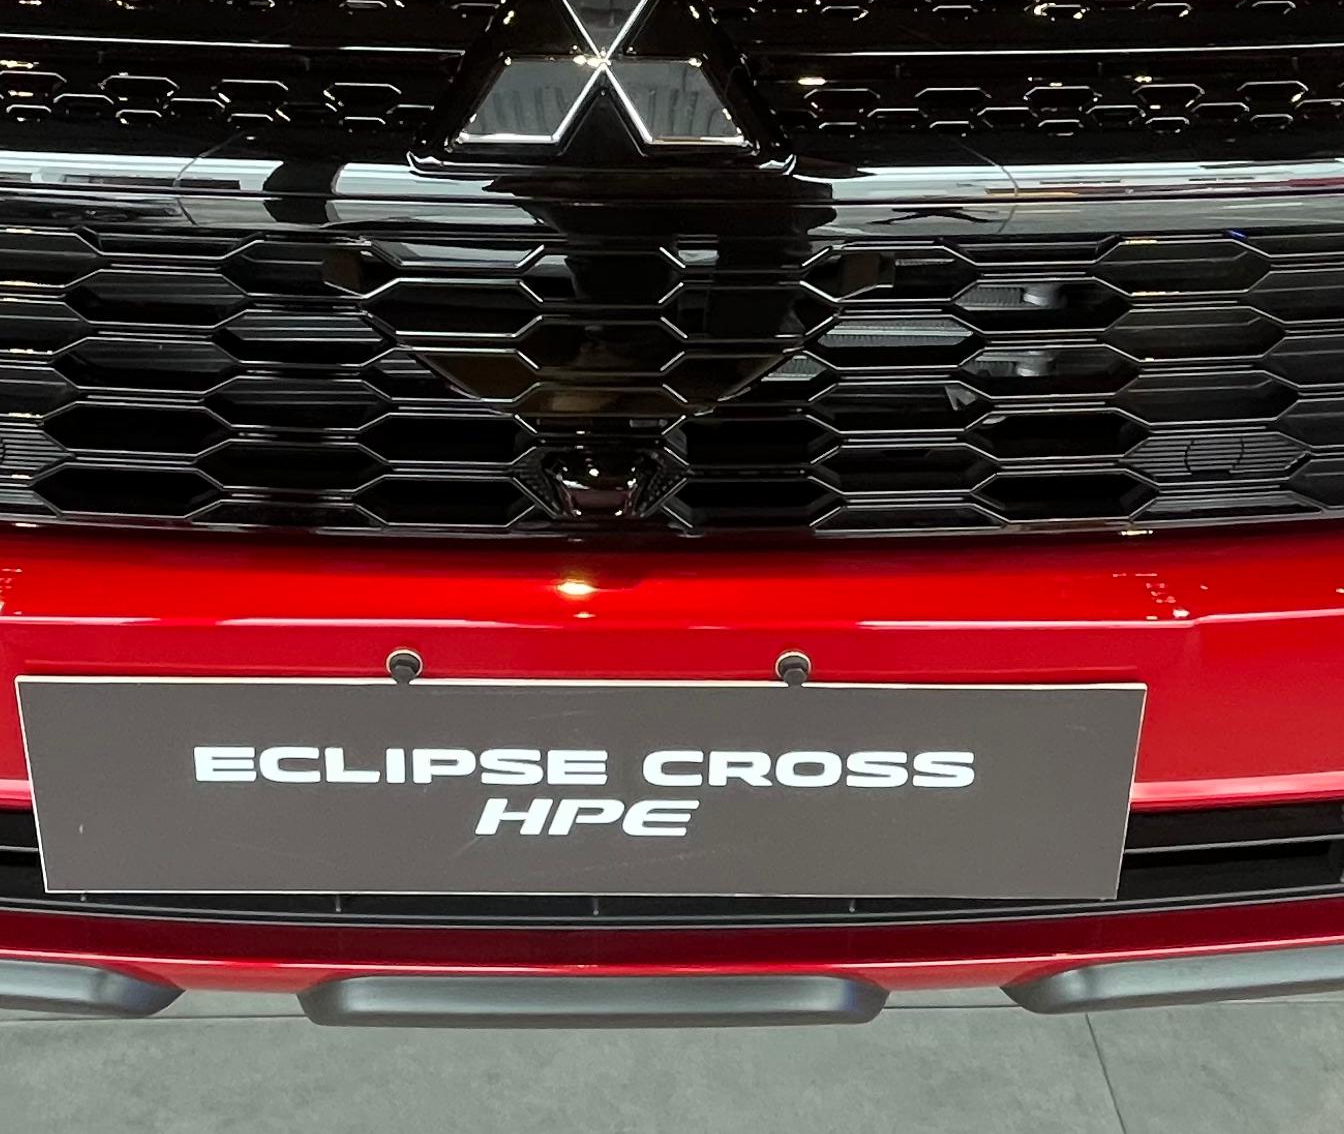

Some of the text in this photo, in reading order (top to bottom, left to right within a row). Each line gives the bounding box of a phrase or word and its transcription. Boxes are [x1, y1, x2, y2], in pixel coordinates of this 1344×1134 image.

[193, 746, 975, 788] ECLIPSE CROSS
[474, 798, 700, 837] HPE
